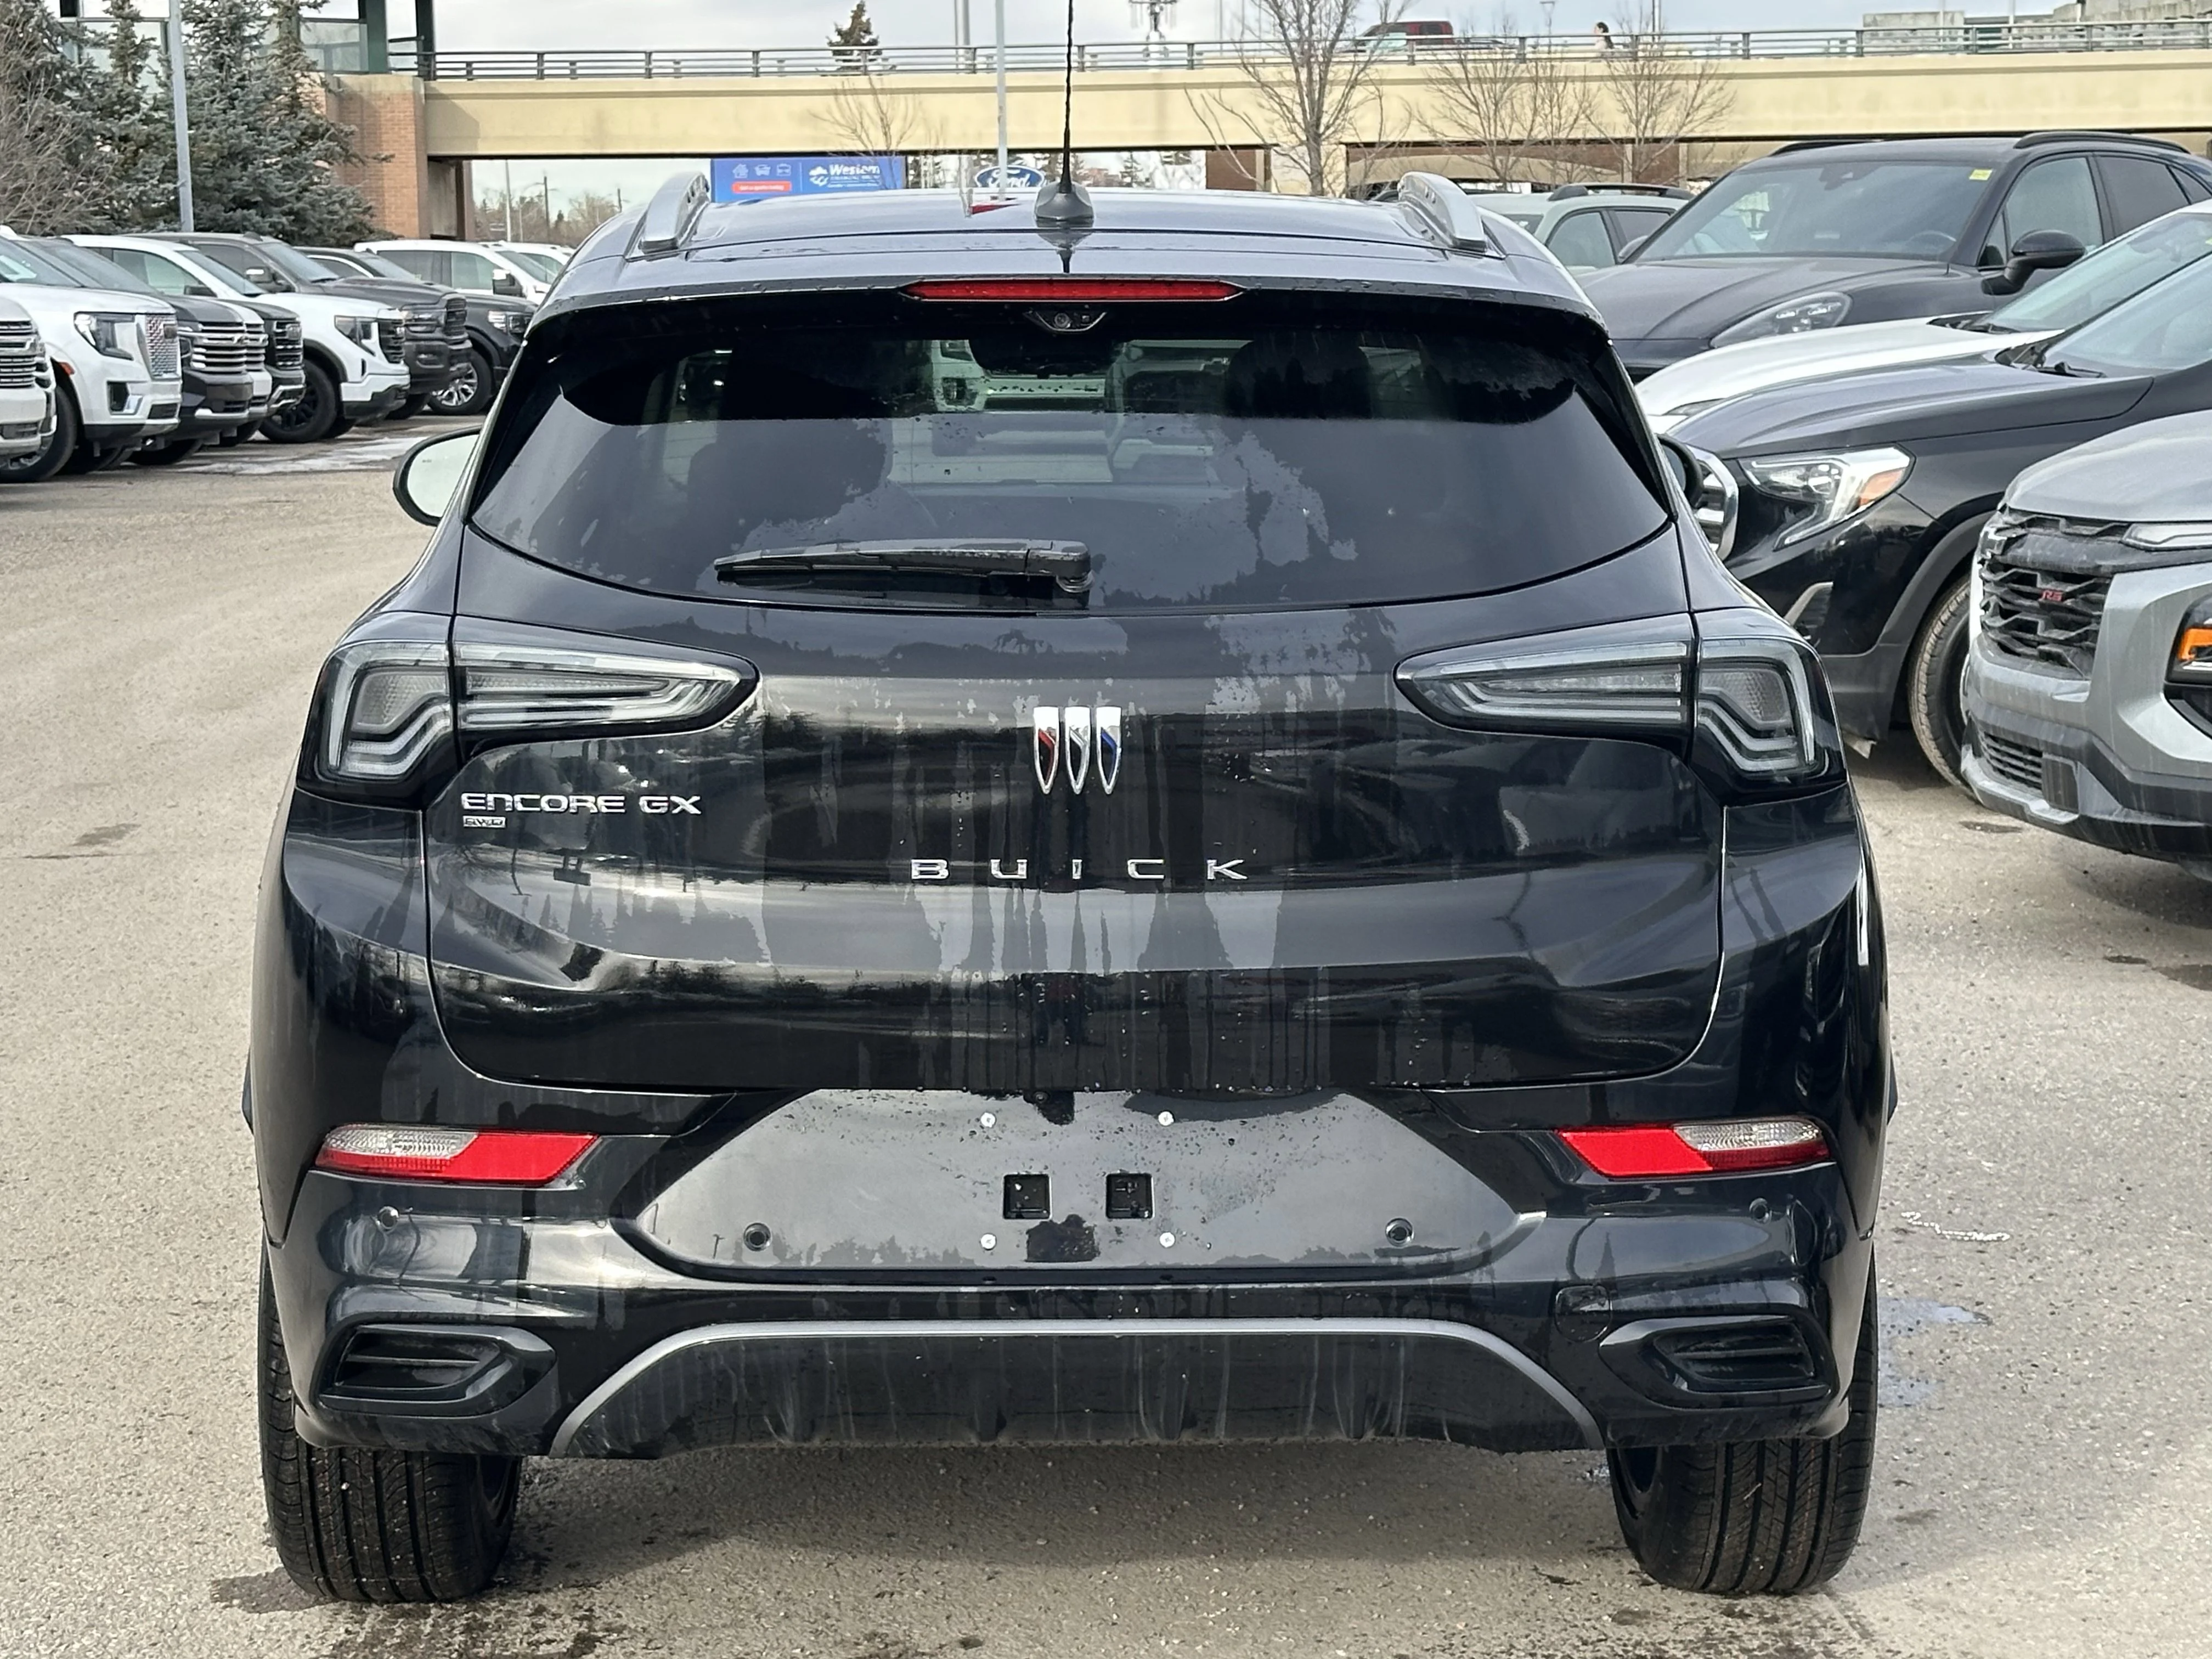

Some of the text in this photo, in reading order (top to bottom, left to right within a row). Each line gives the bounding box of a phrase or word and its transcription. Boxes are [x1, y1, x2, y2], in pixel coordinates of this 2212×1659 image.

[2039, 590, 2063, 602] RS
[461, 793, 702, 815] ENCORE GX
[465, 817, 504, 827] AWD
[911, 859, 1248, 880] BUICK
